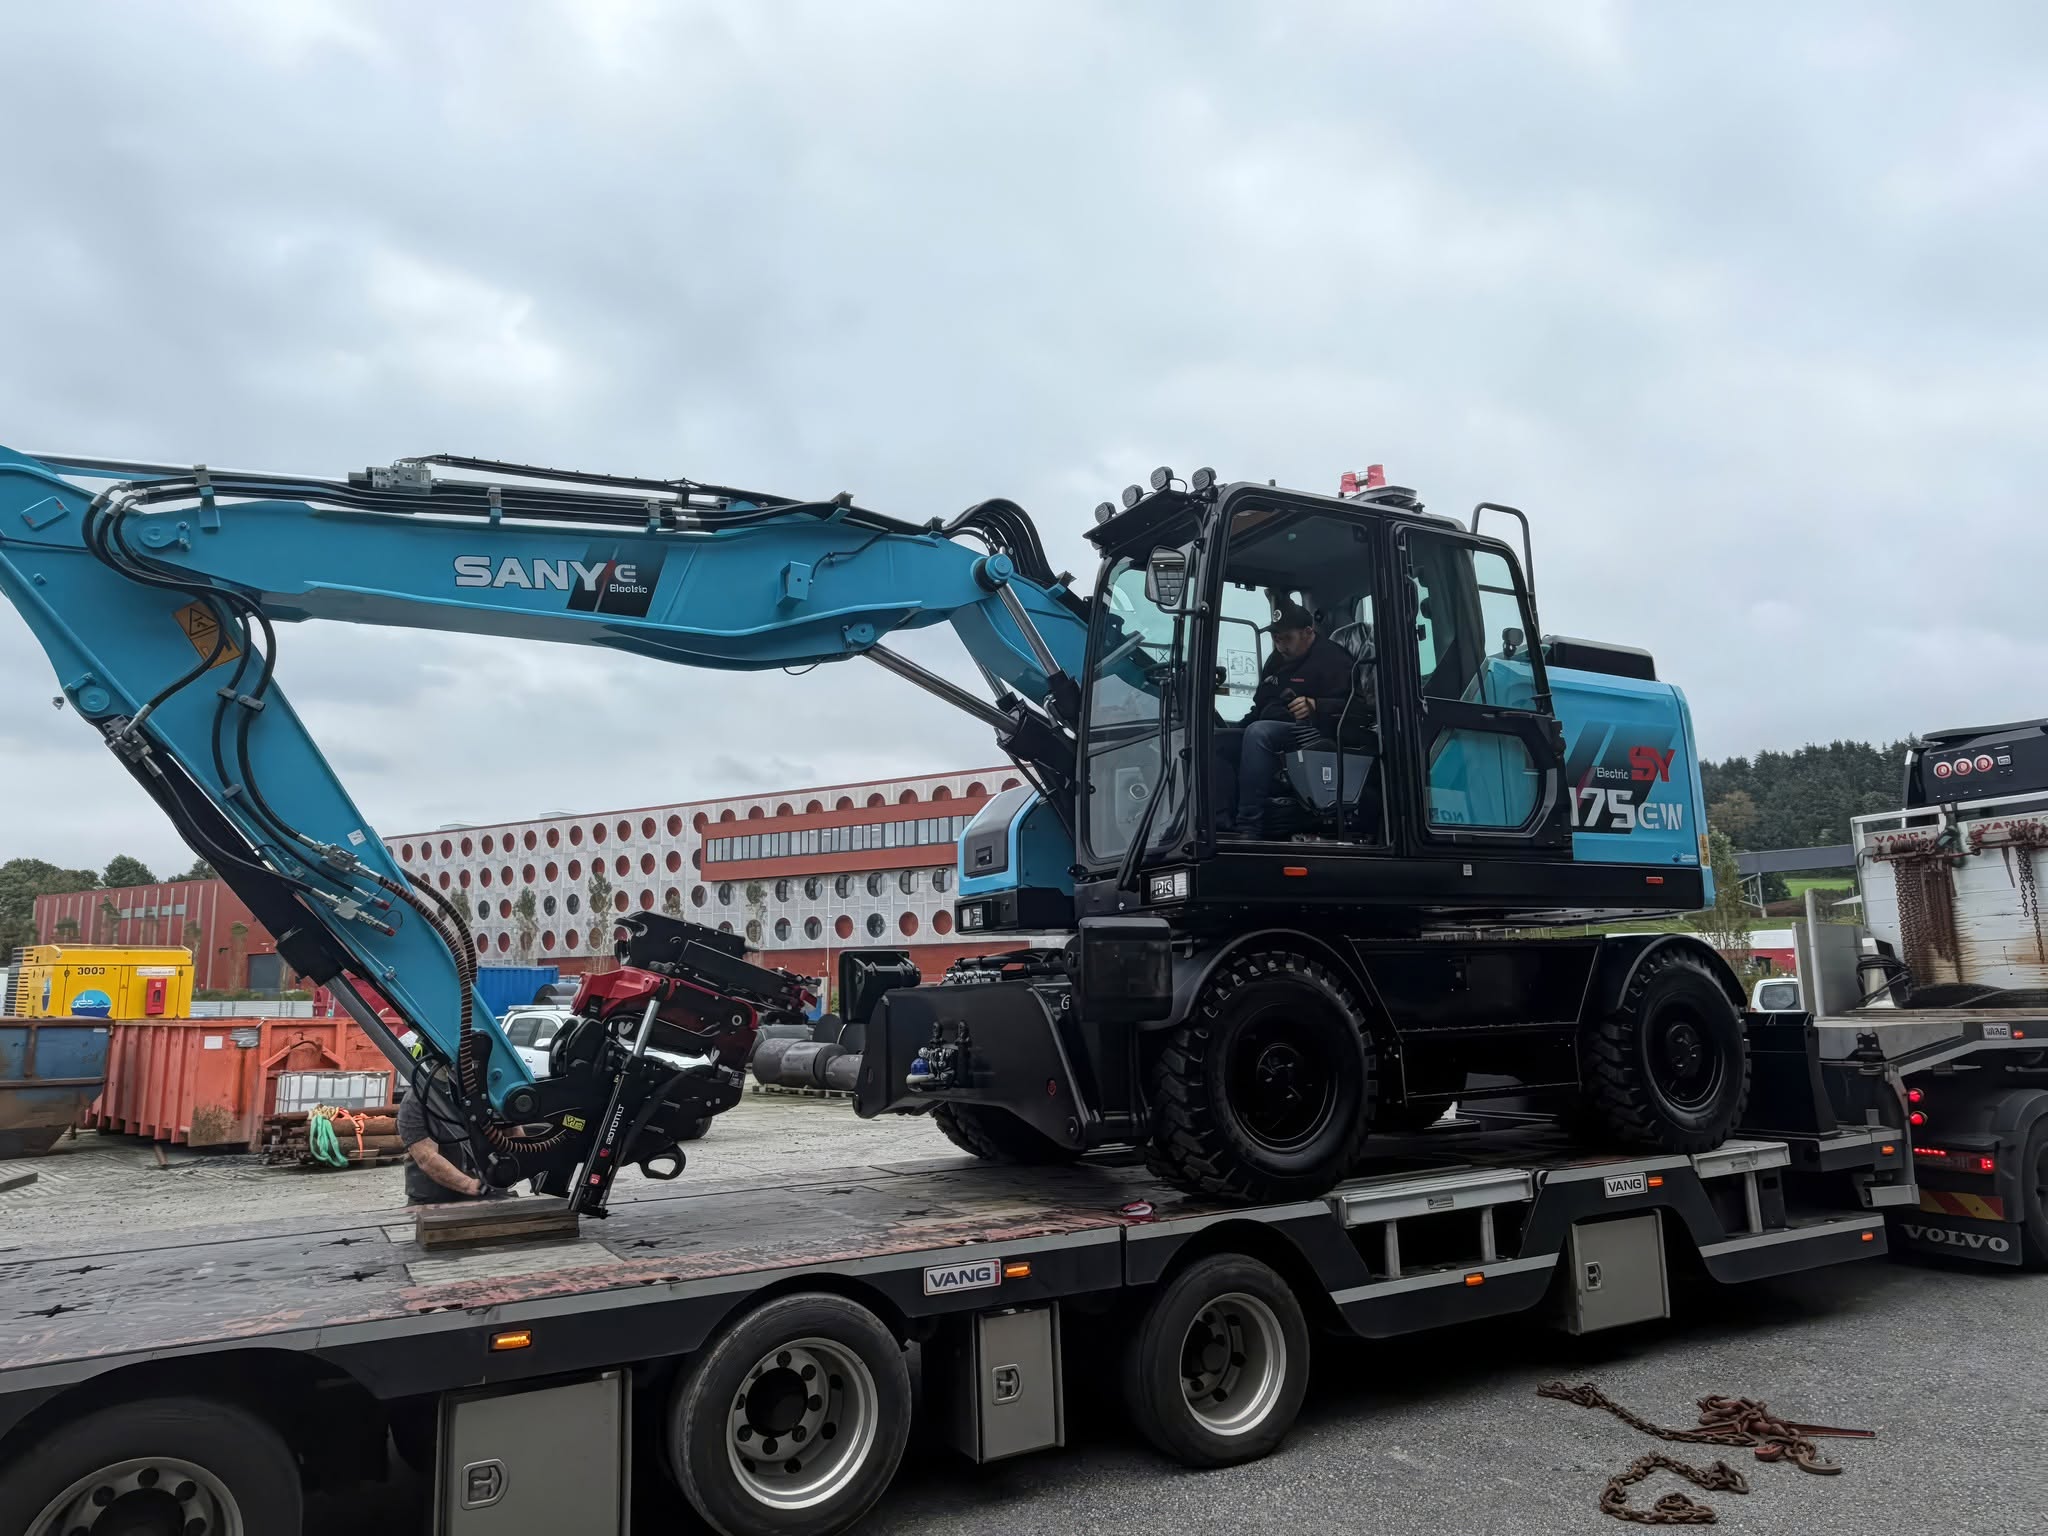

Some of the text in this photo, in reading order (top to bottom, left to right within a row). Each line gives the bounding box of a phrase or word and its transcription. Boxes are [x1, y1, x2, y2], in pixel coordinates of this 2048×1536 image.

[454, 555, 607, 592] SANY
[1596, 766, 1629, 780] Electric
[1629, 744, 1676, 782] SY
[77, 966, 106, 976] 3003
[1607, 1178, 1642, 1193] VANG
[1899, 1223, 2010, 1252] VOLVO
[929, 1266, 991, 1288] VANG
